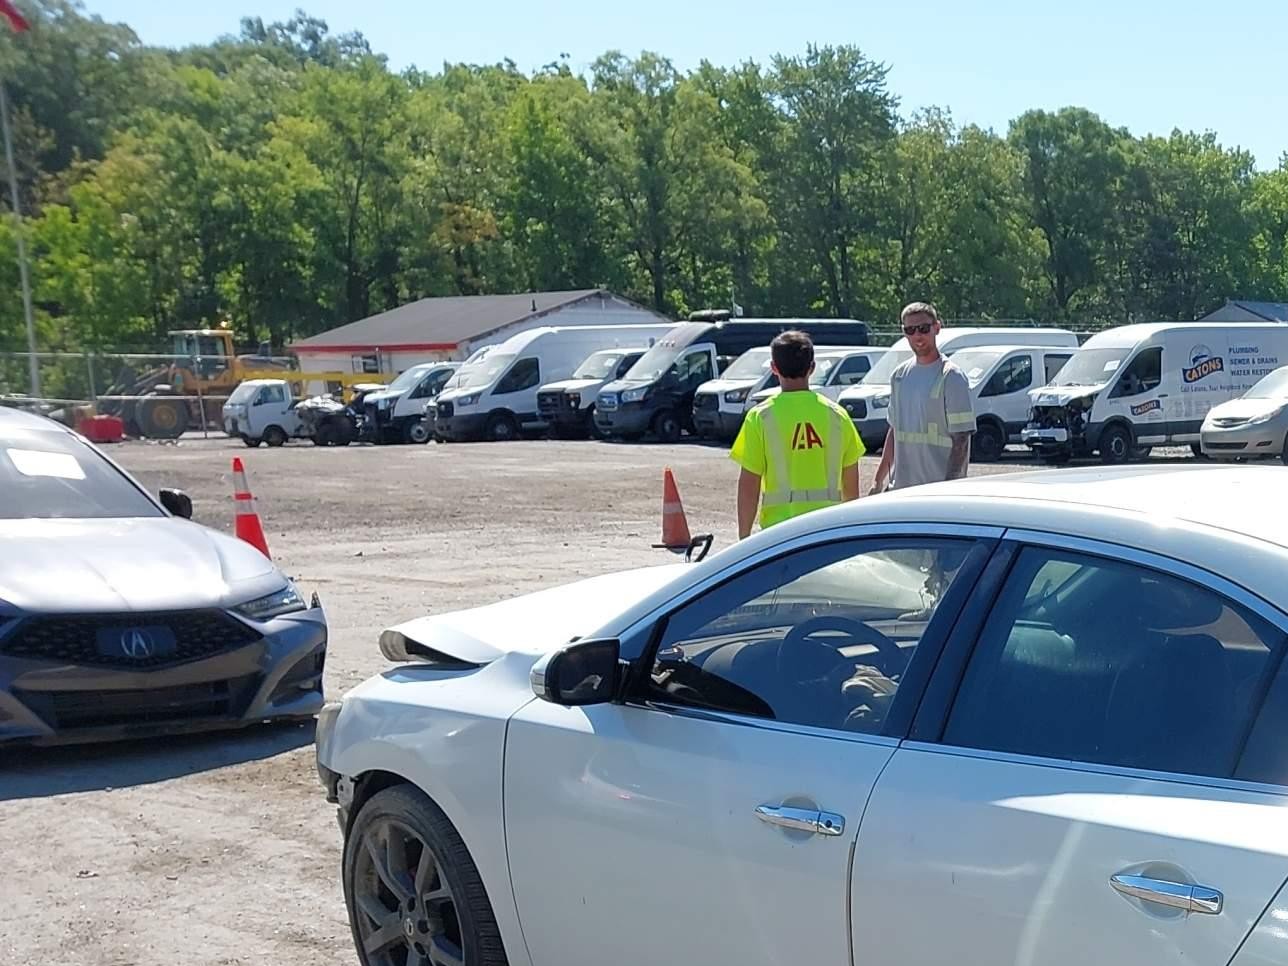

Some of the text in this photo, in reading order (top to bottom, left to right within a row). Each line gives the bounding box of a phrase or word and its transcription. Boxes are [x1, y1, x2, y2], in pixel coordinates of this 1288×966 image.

[1228, 346, 1259, 354] PLUMBING
[1257, 356, 1278, 364] DRAINS
[1184, 359, 1222, 381] CATONS
